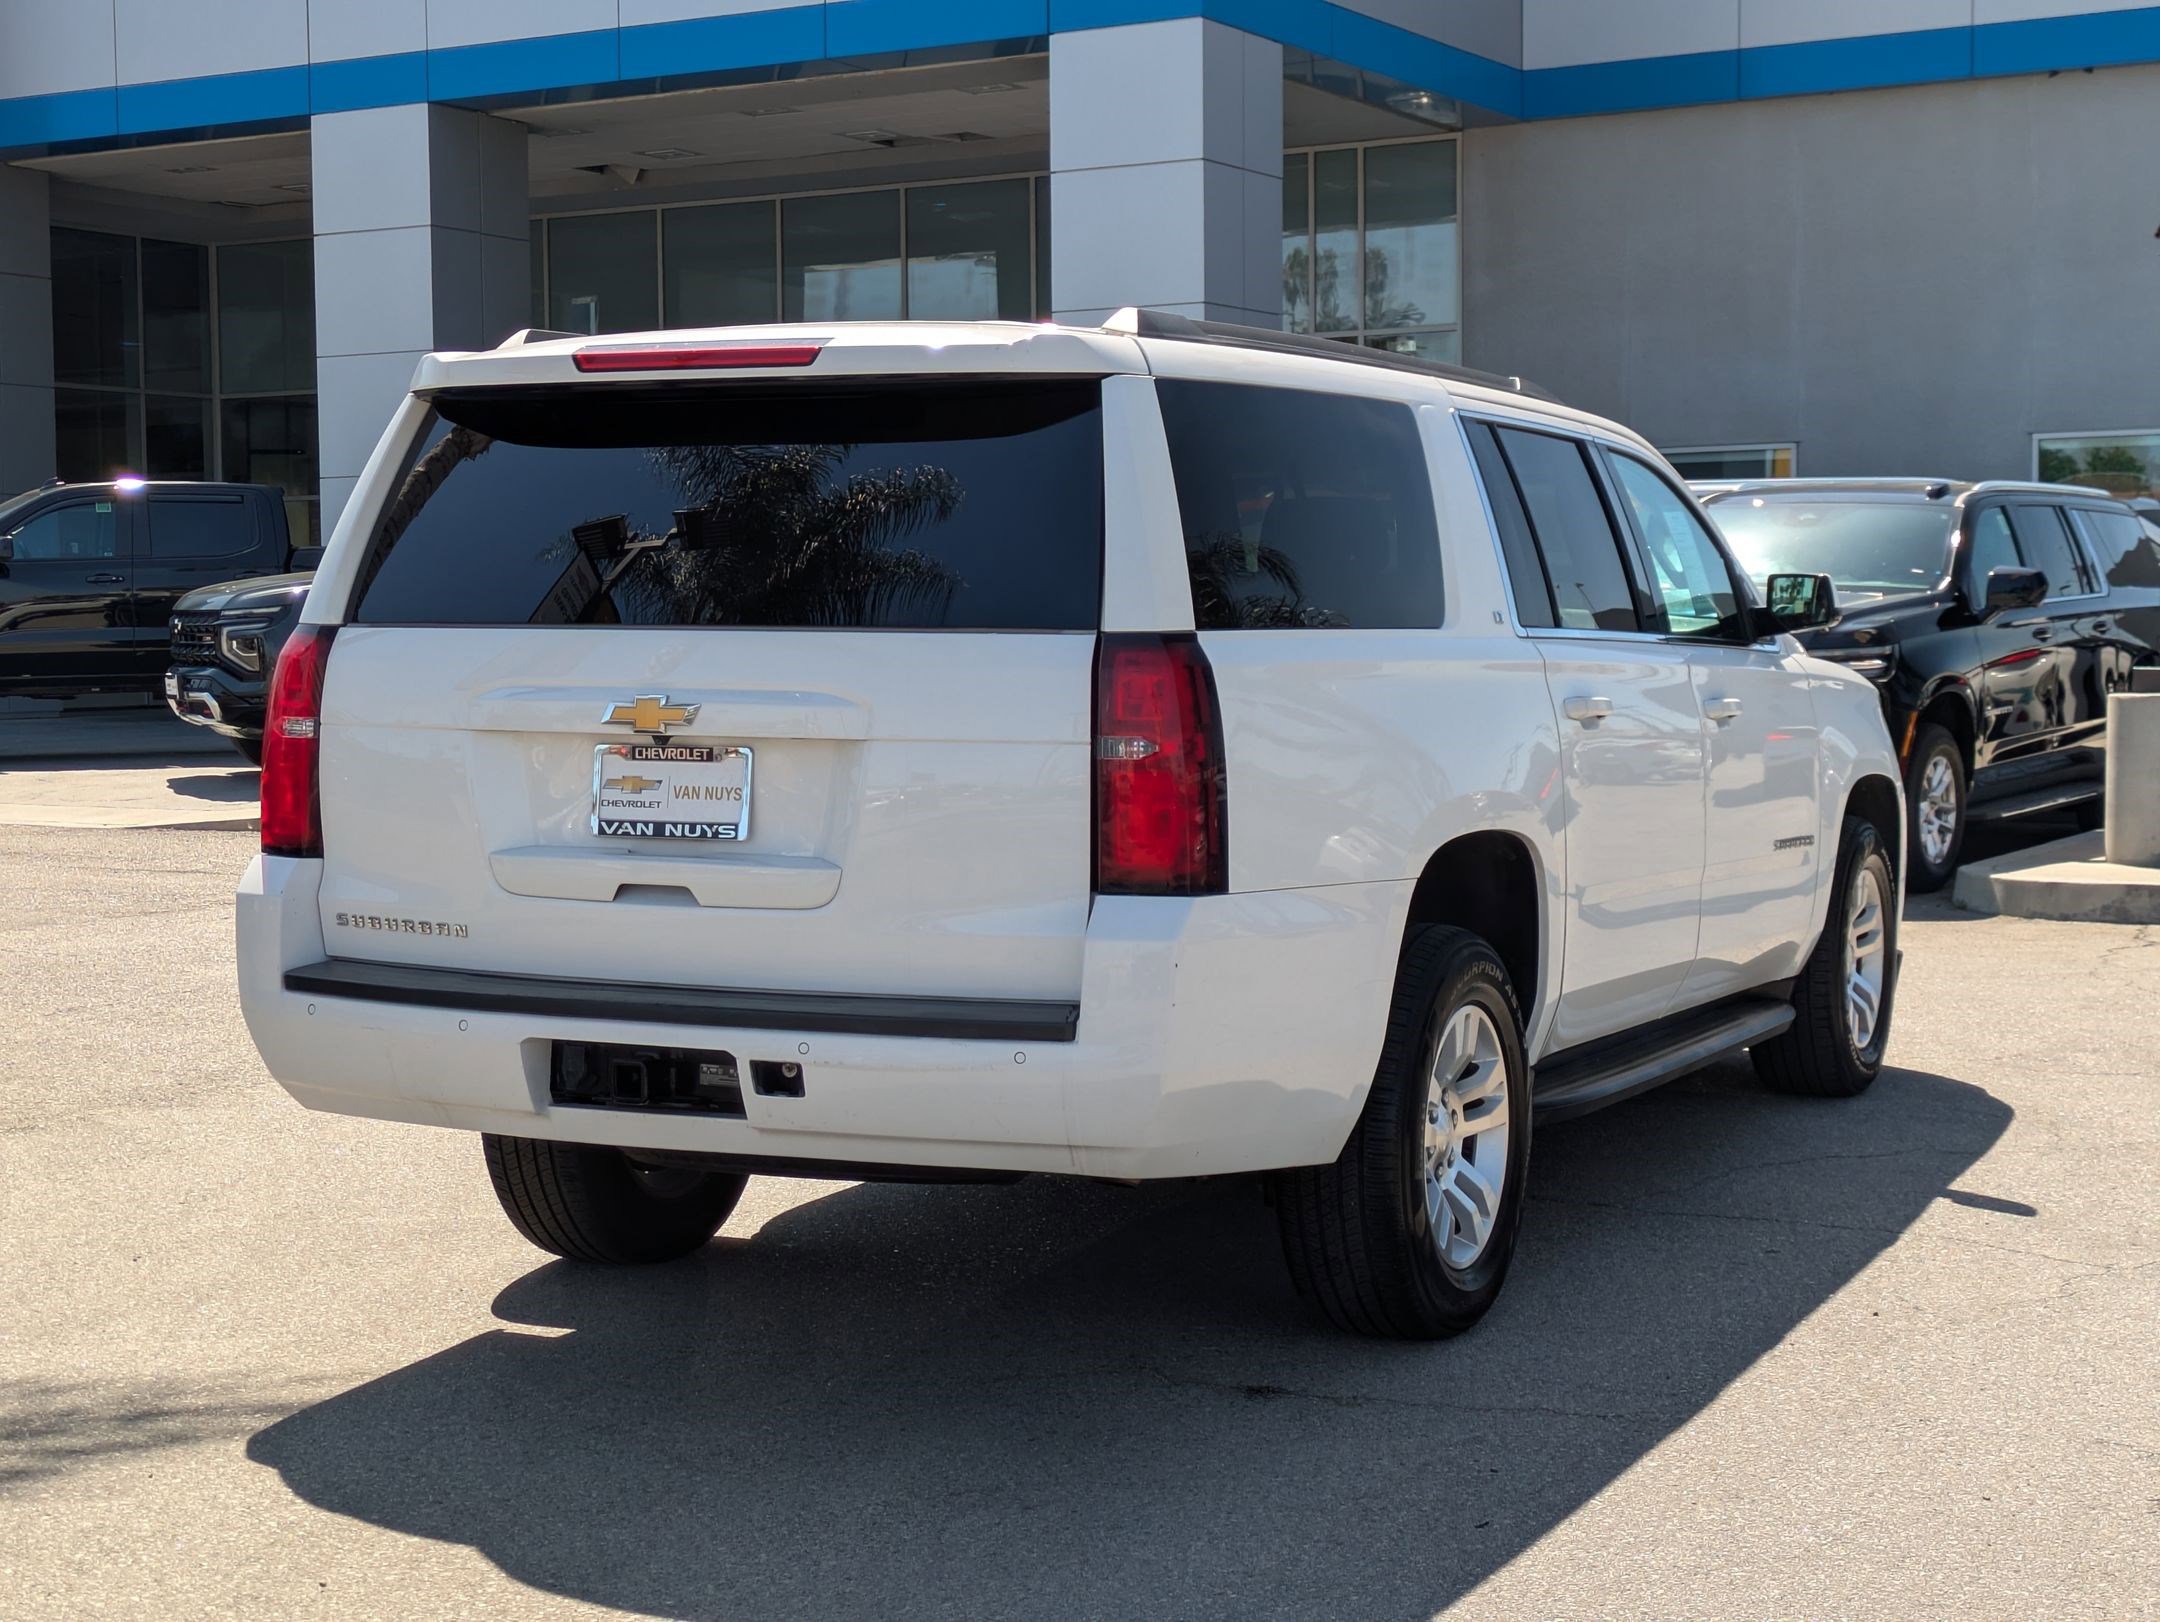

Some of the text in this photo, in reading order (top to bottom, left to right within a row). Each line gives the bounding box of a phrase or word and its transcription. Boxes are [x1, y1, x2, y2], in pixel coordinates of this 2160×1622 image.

[635, 747, 710, 761] CHEVROLET
[673, 785, 743, 802] VAN NUYS
[600, 799, 663, 809] CHEVROLET
[600, 821, 737, 839] VAN NUYS
[336, 912, 469, 939] SUBURBAN
